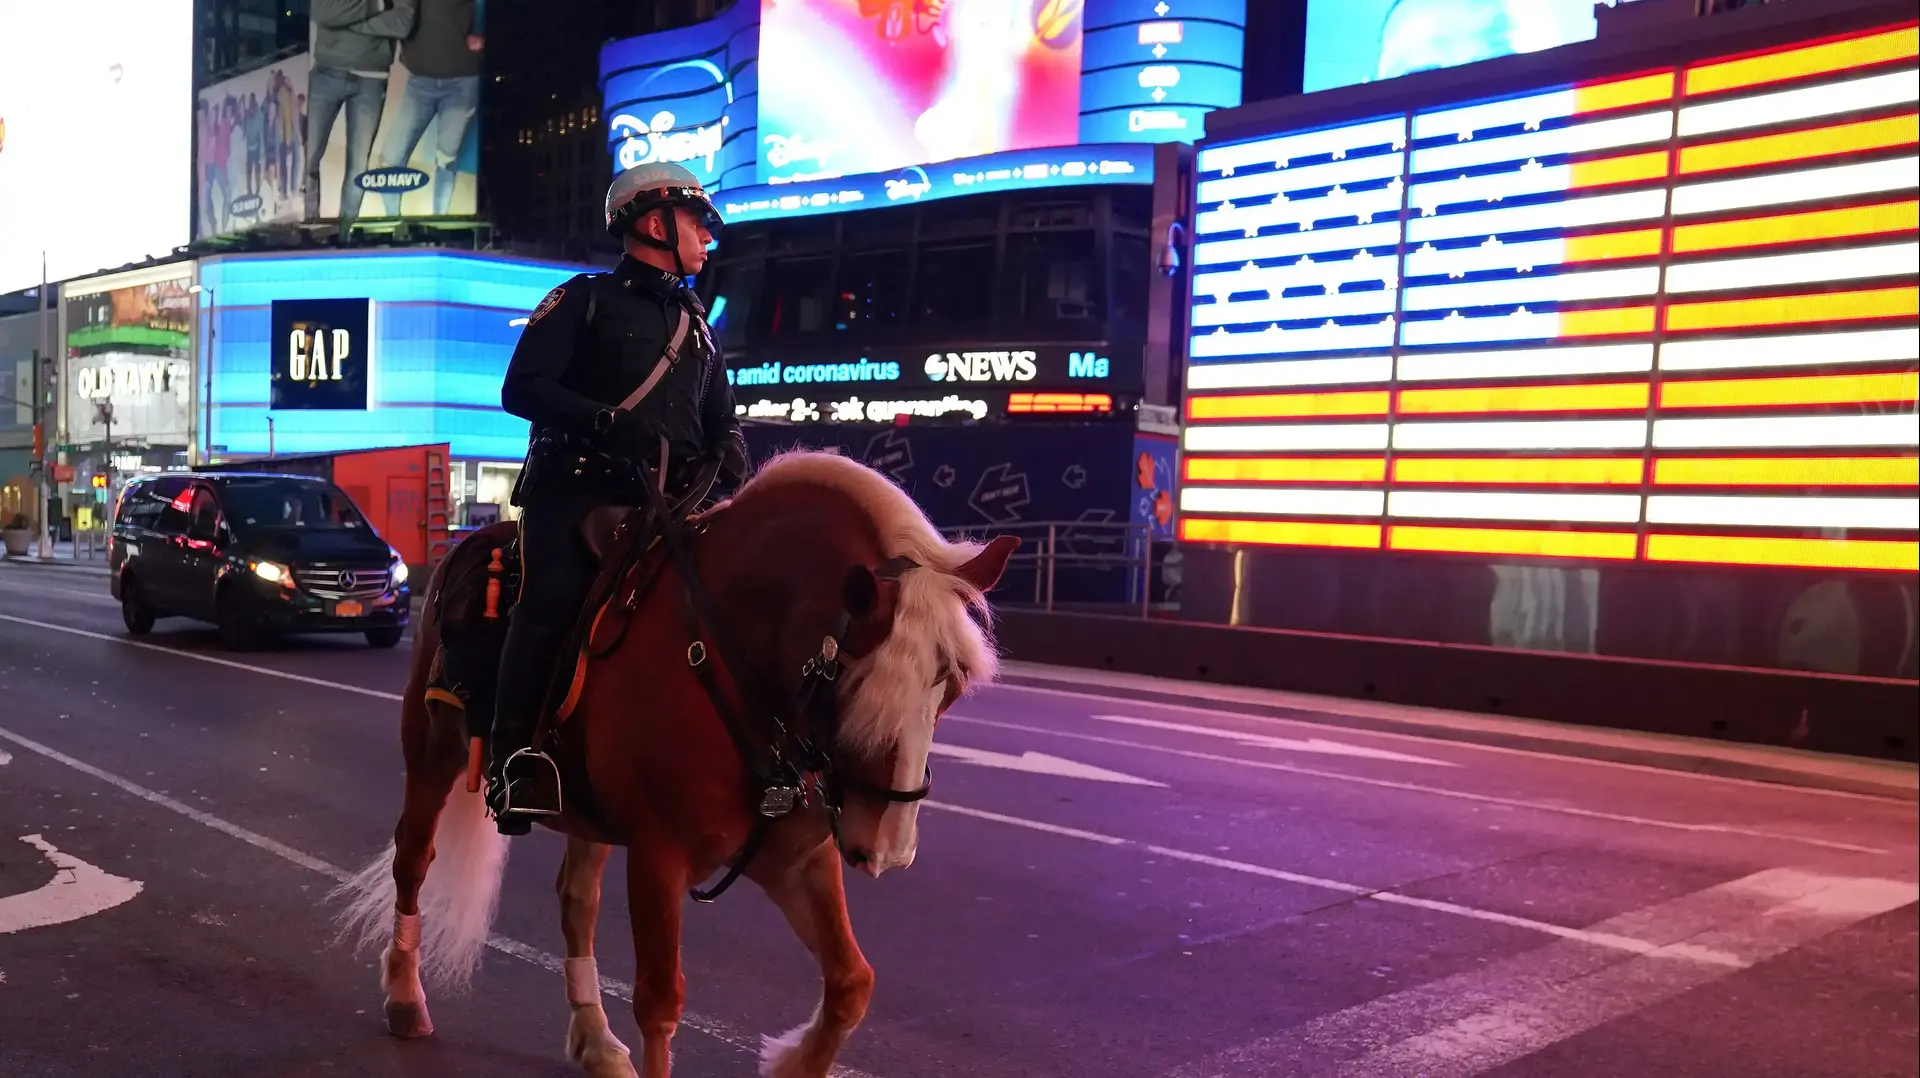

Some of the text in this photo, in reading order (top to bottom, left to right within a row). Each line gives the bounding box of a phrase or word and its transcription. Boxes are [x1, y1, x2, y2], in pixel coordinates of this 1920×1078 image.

[362, 173, 422, 188] OLD NAVY
[290, 329, 350, 380] GAP
[946, 351, 1037, 381] NEWS
[1068, 352, 1109, 378] Ma
[78, 361, 166, 399] OLD NAVY
[736, 361, 781, 385] amid
[783, 358, 900, 383] coronavirus
[1008, 393, 1111, 412] ESPN
